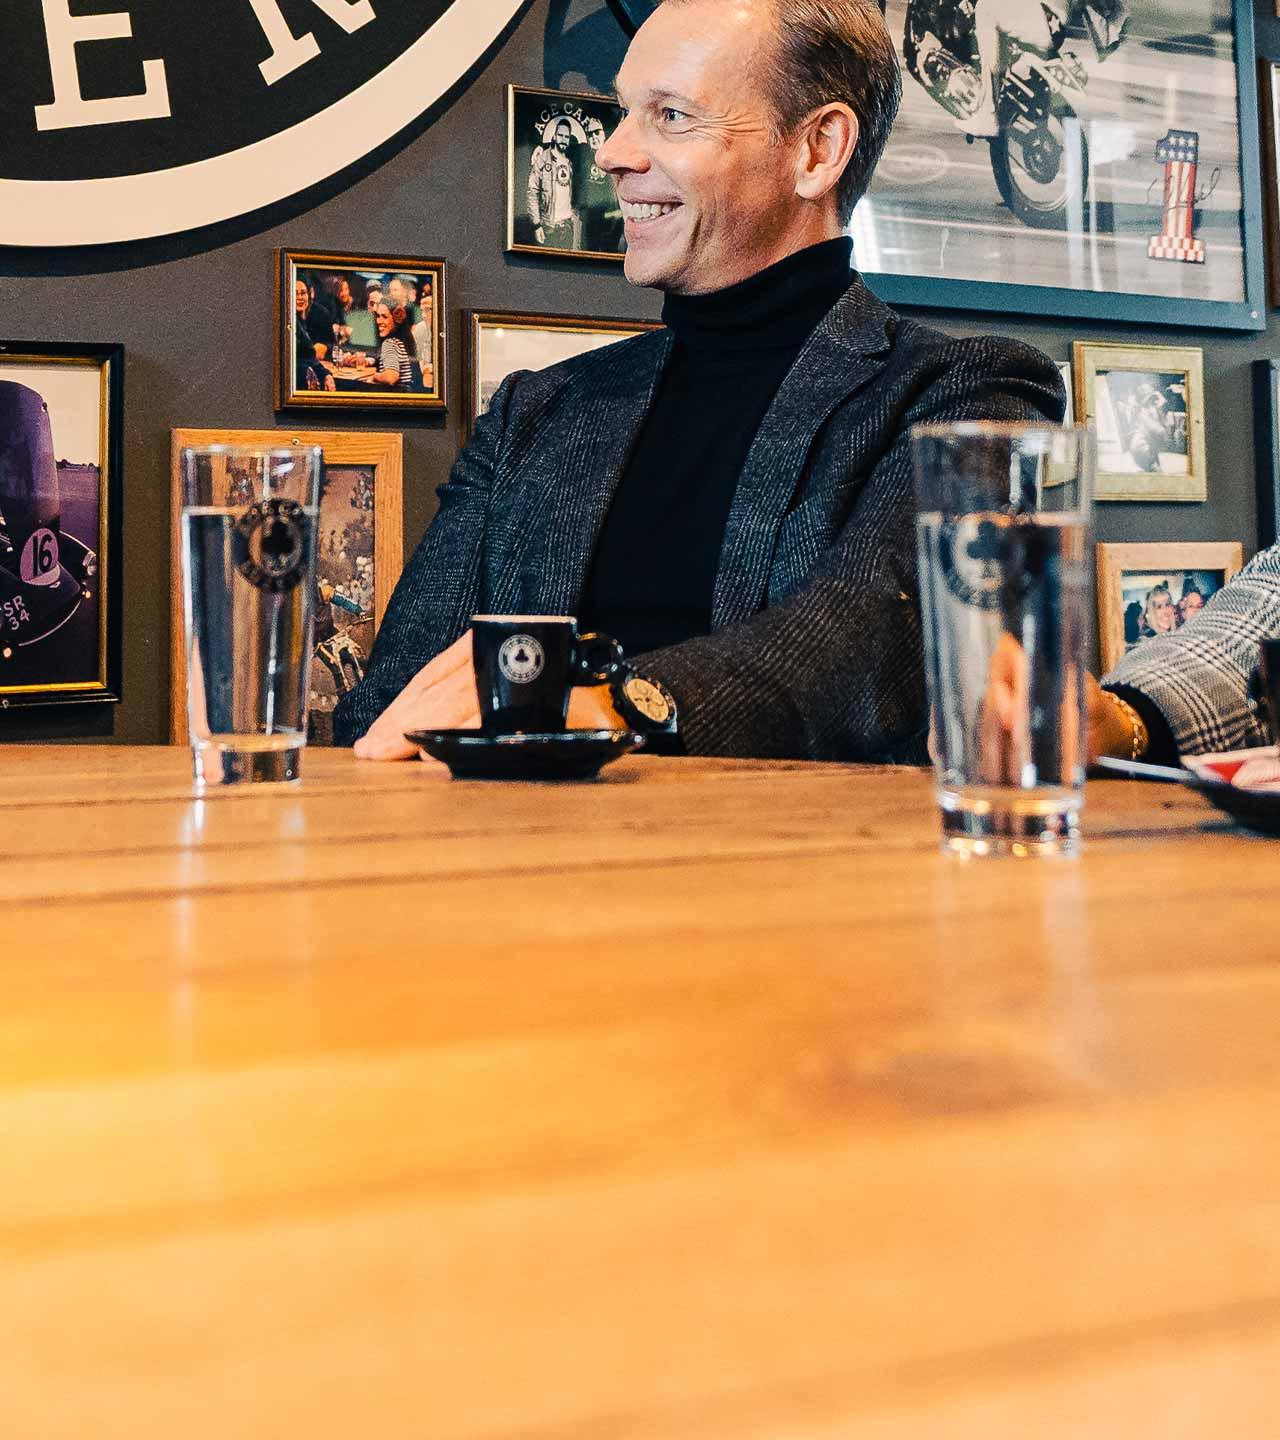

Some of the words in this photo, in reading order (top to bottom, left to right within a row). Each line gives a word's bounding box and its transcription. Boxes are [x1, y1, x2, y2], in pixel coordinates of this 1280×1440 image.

[563, 102, 591, 129] CAF
[31, 533, 53, 578] 16
[3, 595, 25, 618] SR
[8, 608, 31, 631] 34
